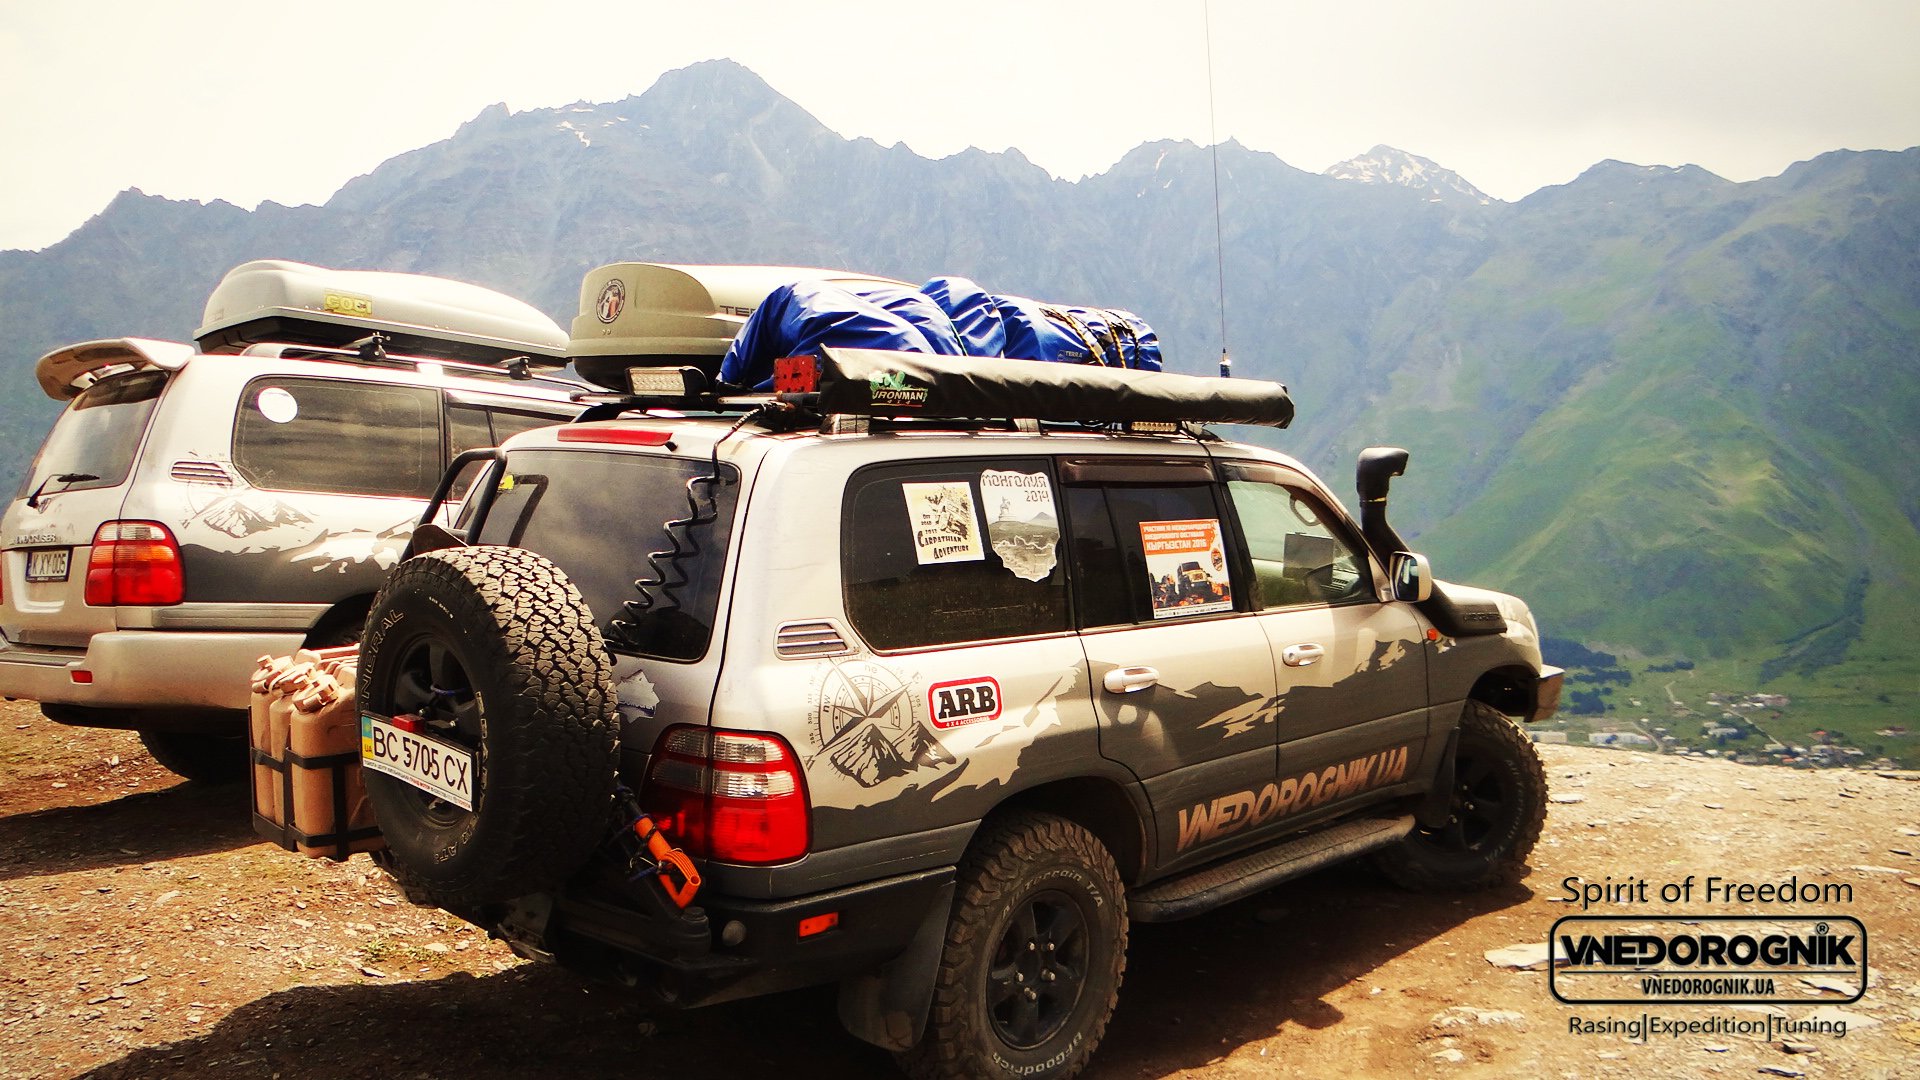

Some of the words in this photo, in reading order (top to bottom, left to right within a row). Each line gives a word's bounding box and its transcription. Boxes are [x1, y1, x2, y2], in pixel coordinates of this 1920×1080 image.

[1024, 490, 1050, 503] 2014
[917, 530, 962, 548] CARPATHIAN
[933, 545, 969, 560] ADVENTURE
[938, 686, 996, 719] ARB
[373, 726, 399, 763] BC
[402, 736, 440, 780] 5705
[444, 754, 468, 795] CX
